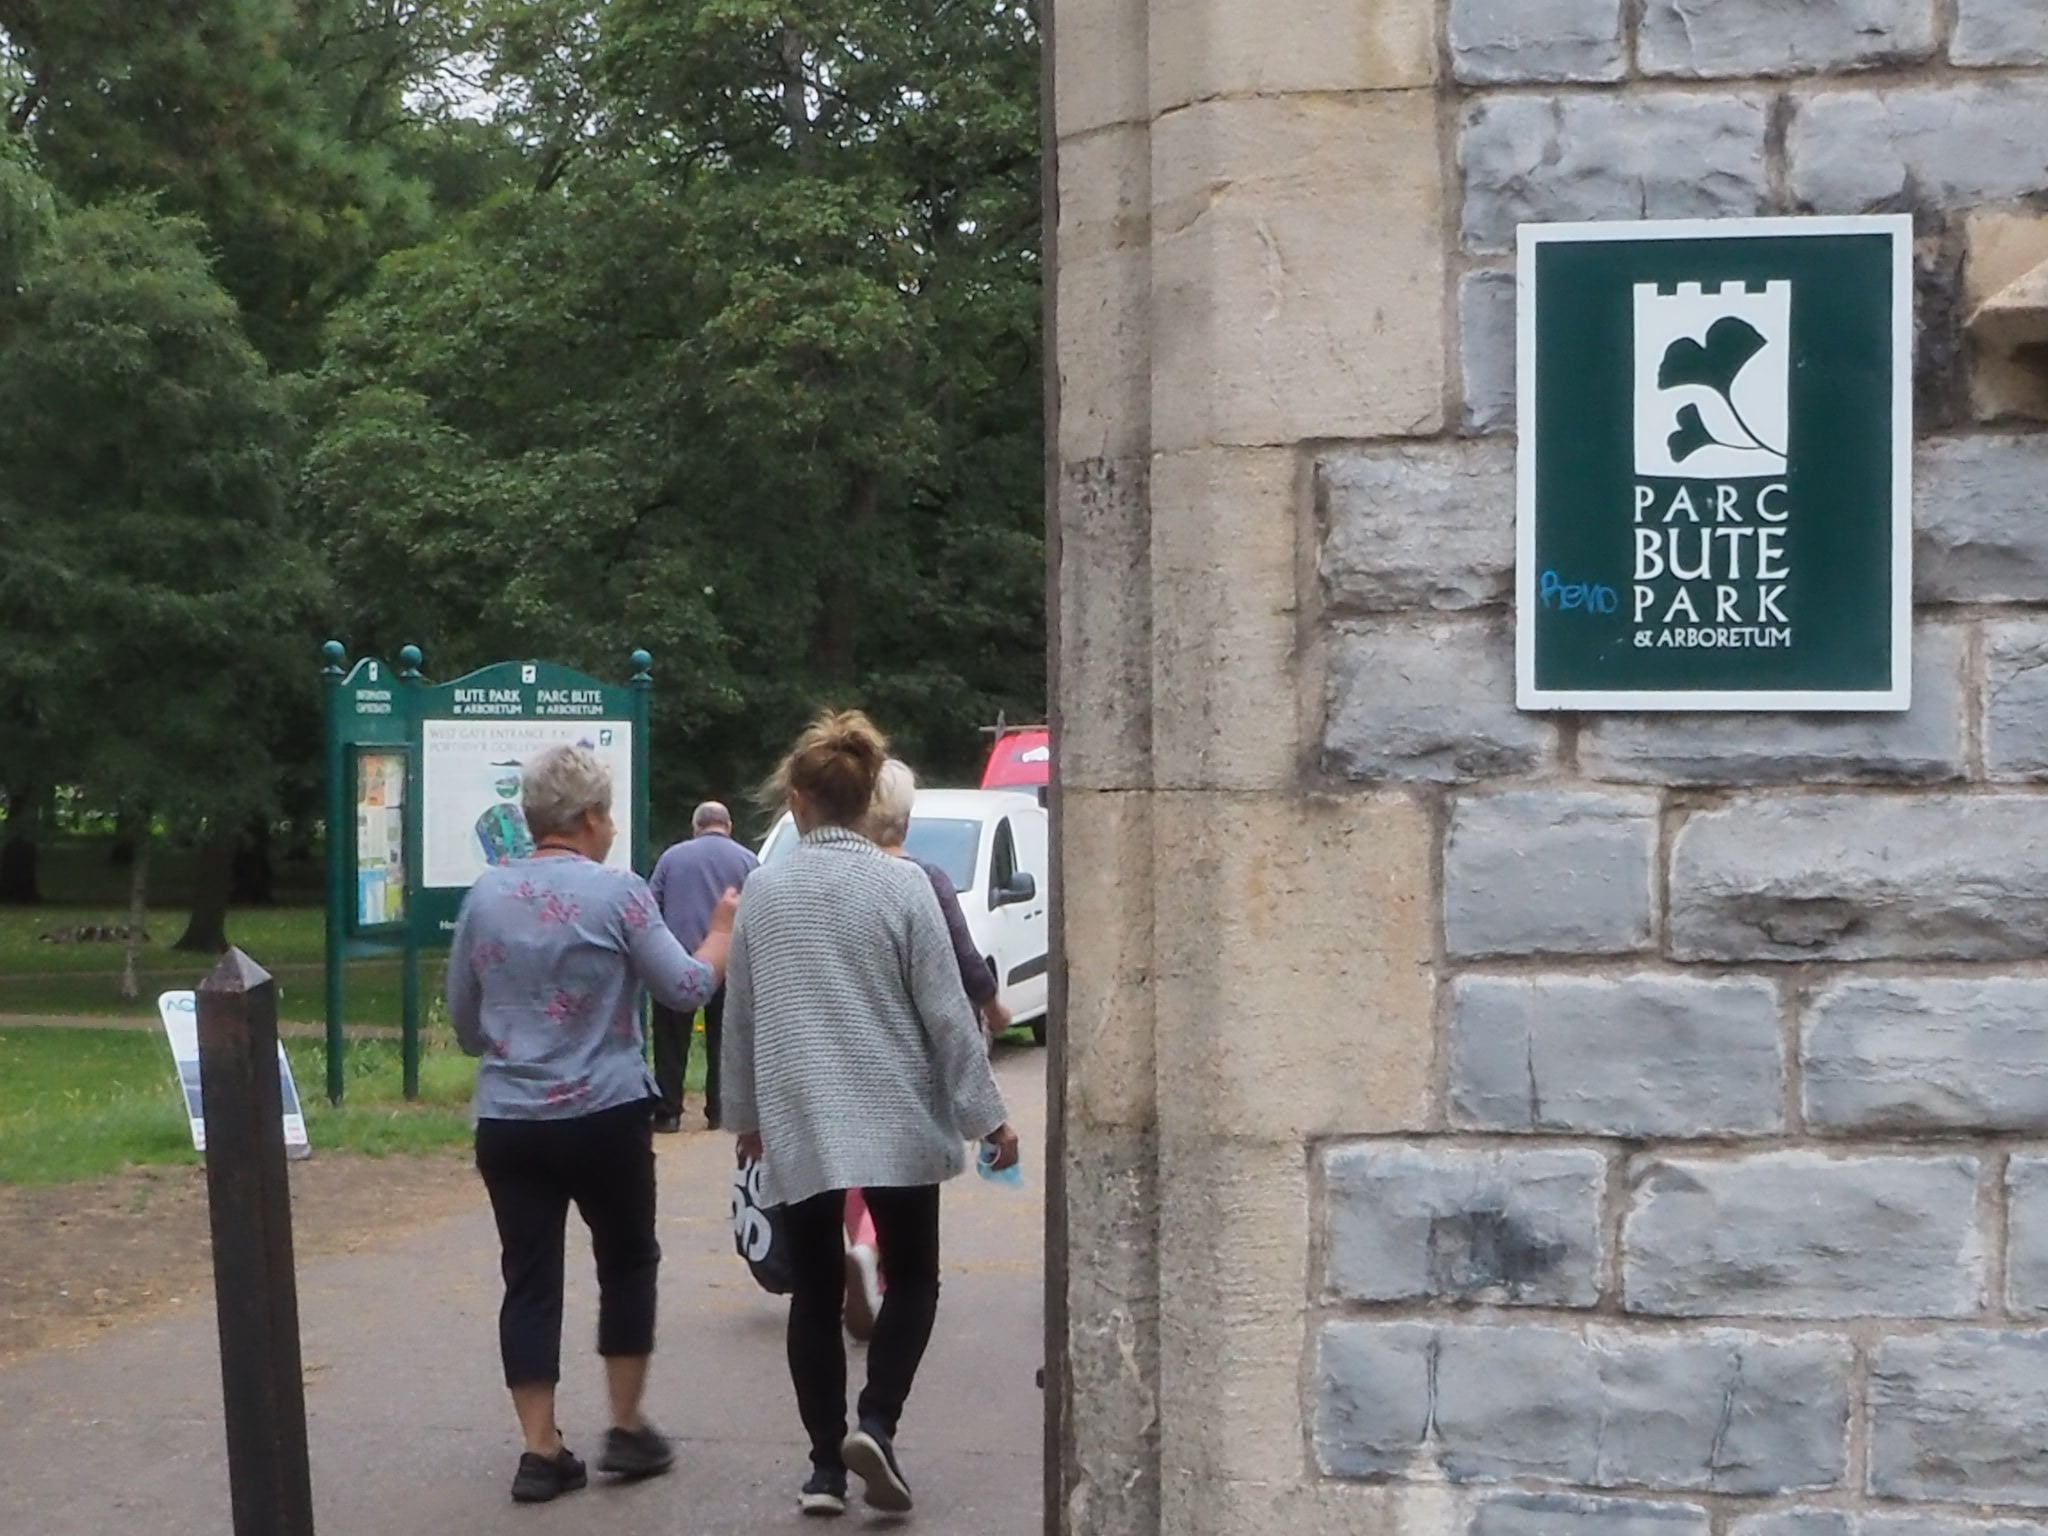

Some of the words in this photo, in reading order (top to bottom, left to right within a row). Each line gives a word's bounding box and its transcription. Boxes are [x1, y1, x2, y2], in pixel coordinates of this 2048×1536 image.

[1634, 484, 1788, 523] PARC
[1633, 527, 1790, 580] BUTE
[1633, 585, 1788, 623] PARK
[1633, 630, 1653, 647] &
[1657, 628, 1791, 647] ARBORETUM
[454, 689, 485, 702] BUTE
[489, 689, 520, 702] PARK
[537, 690, 569, 702] PARC
[571, 690, 601, 702] BUTE
[464, 704, 522, 714] ARBORETUM
[546, 704, 603, 714] ARBORETUM
[430, 728, 456, 739] WEST
[460, 728, 486, 739] GATE
[490, 728, 544, 739] ENTRANCE
